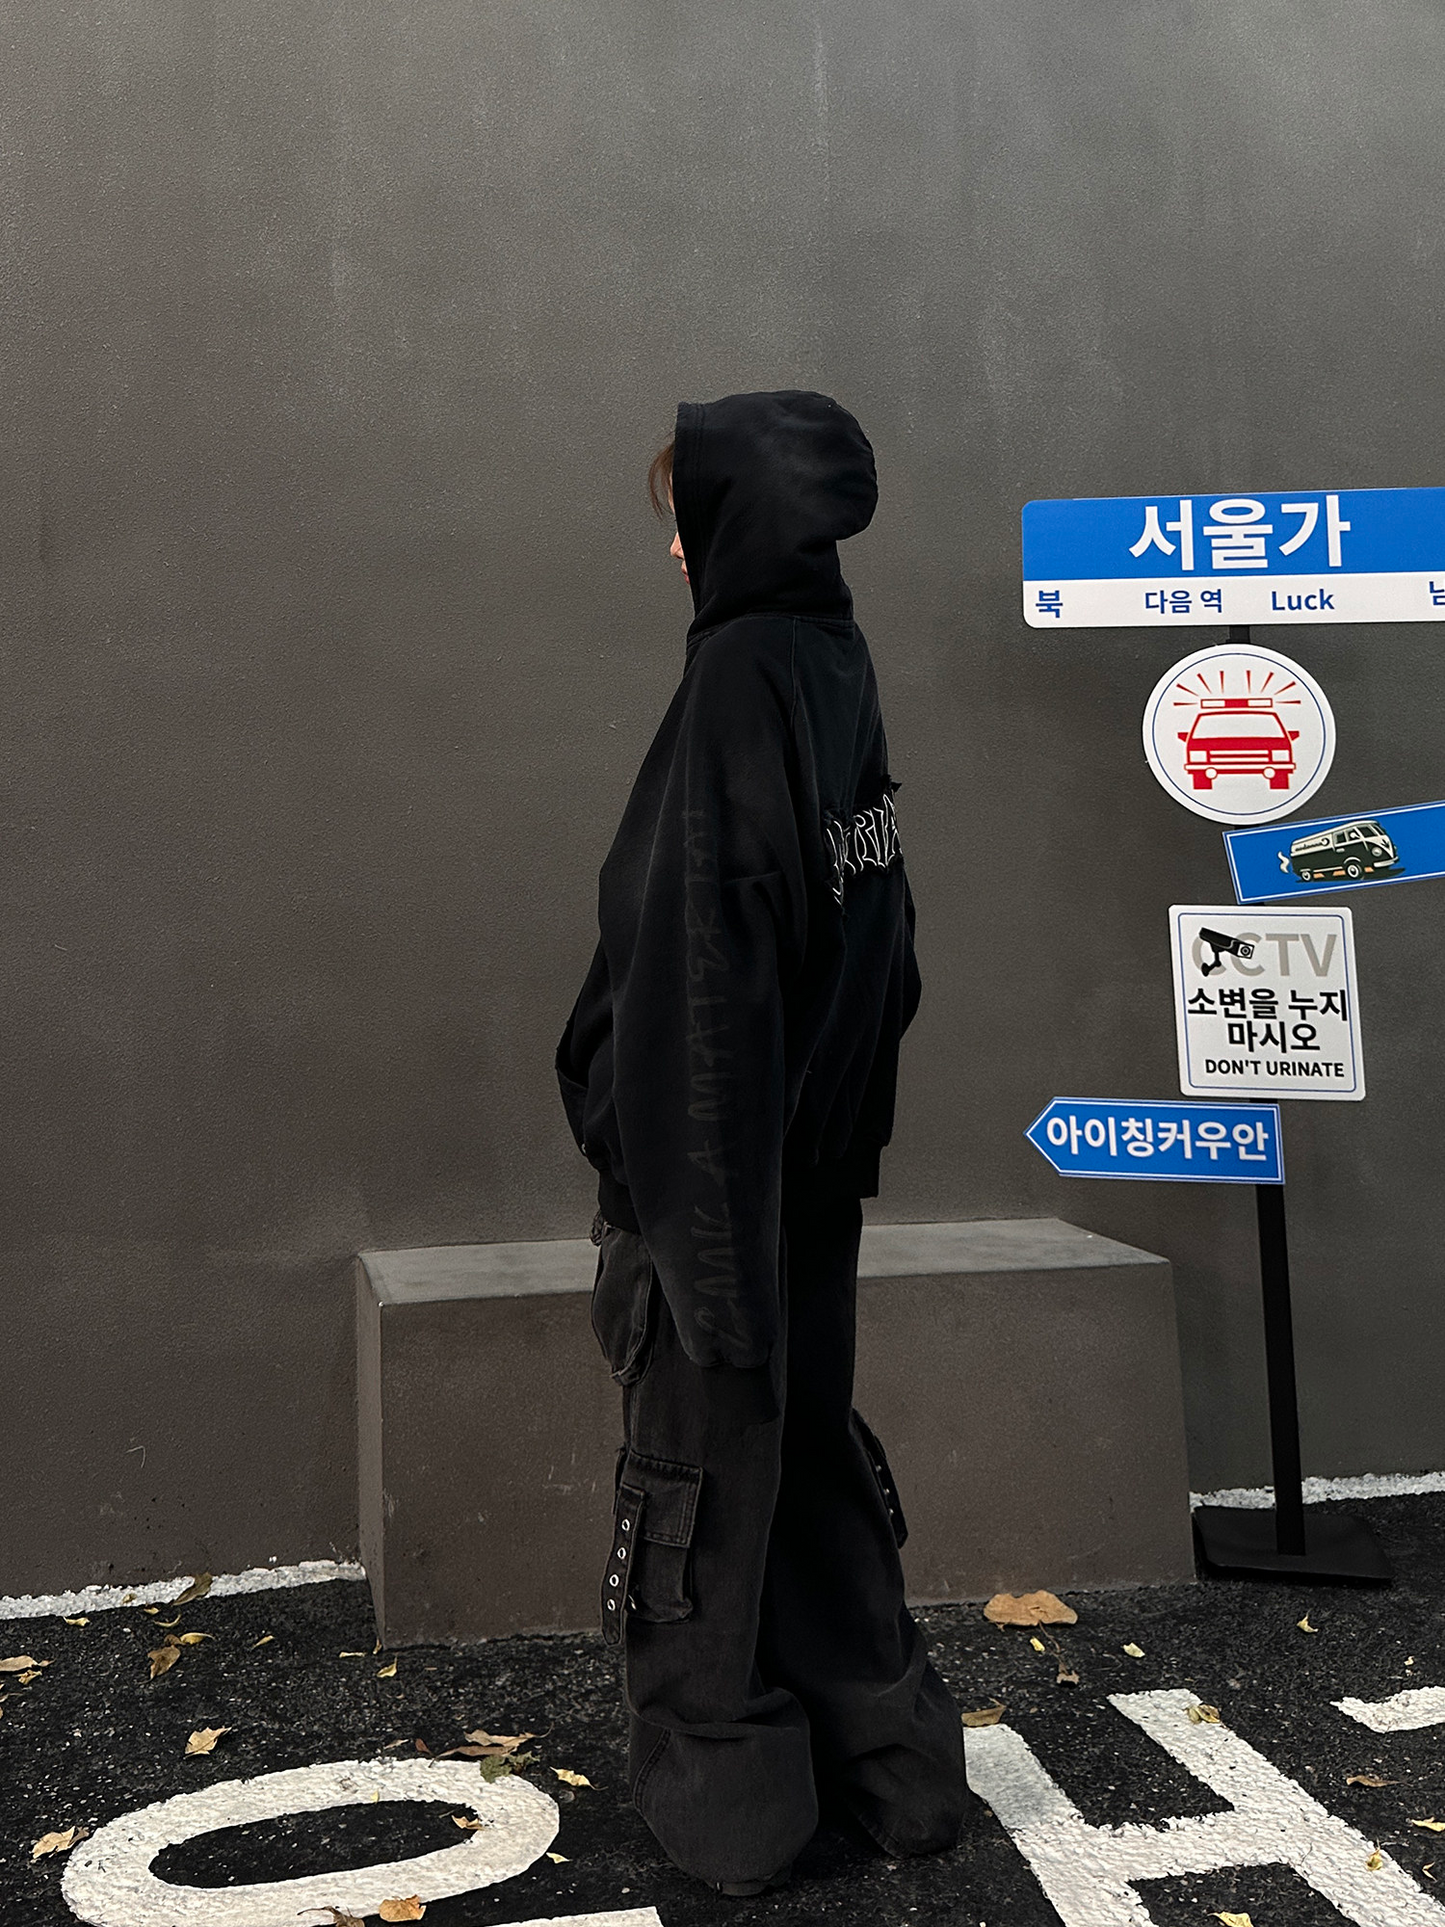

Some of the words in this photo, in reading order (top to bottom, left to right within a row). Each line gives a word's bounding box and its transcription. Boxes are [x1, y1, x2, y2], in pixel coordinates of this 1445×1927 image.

[1129, 495, 1351, 571] 서울가
[1035, 590, 1064, 618] 북
[1145, 590, 1192, 613] 다음
[1200, 589, 1223, 613] 역
[1271, 589, 1335, 611] Luck
[1187, 988, 1279, 1020] 소변을
[1288, 989, 1348, 1021] 누지
[1228, 1021, 1320, 1053] 마시오
[1205, 1059, 1261, 1075] DON'T
[1267, 1061, 1345, 1078] URINATE
[1046, 1115, 1269, 1161] 아이칭커우안
